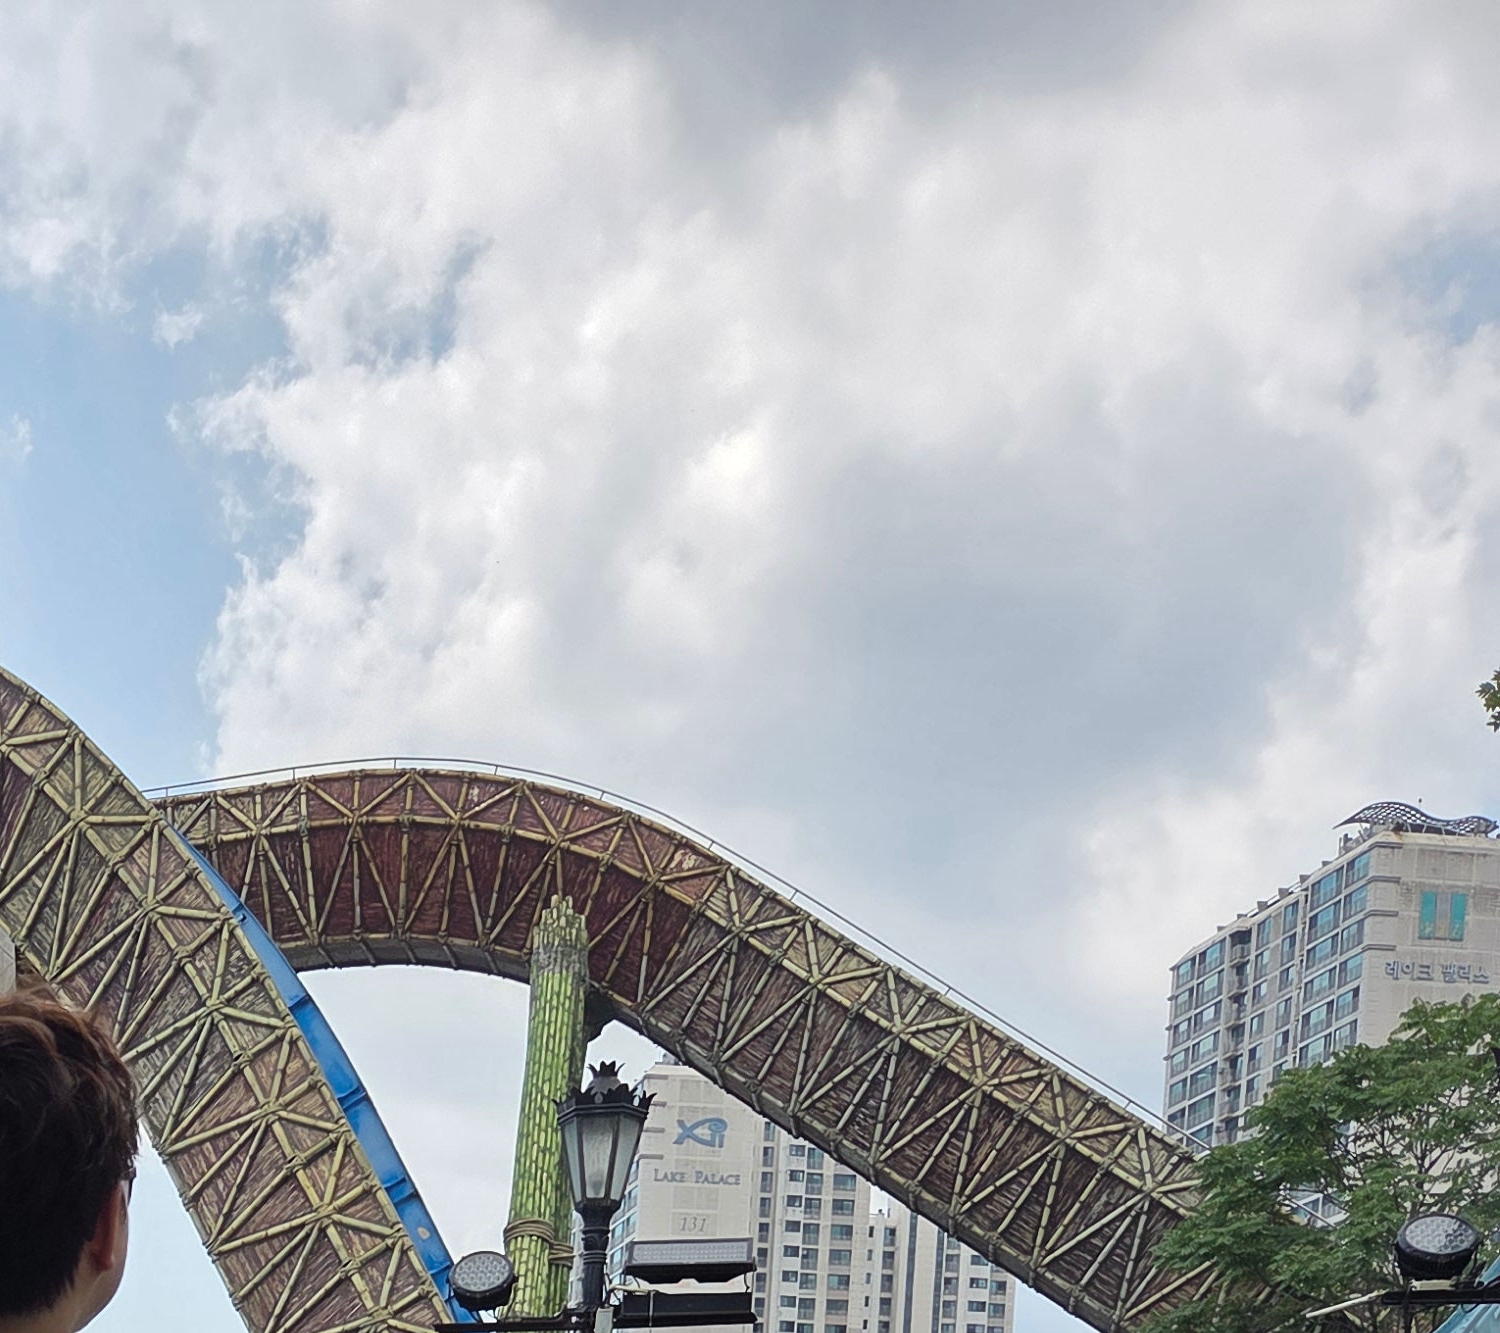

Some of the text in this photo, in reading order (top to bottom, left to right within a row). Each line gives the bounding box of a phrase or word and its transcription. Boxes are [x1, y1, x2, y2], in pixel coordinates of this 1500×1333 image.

[1385, 961, 1490, 984] 레이크 팰리스
[653, 1168, 741, 1185] LAKE PALACE
[680, 1216, 707, 1232] 131
